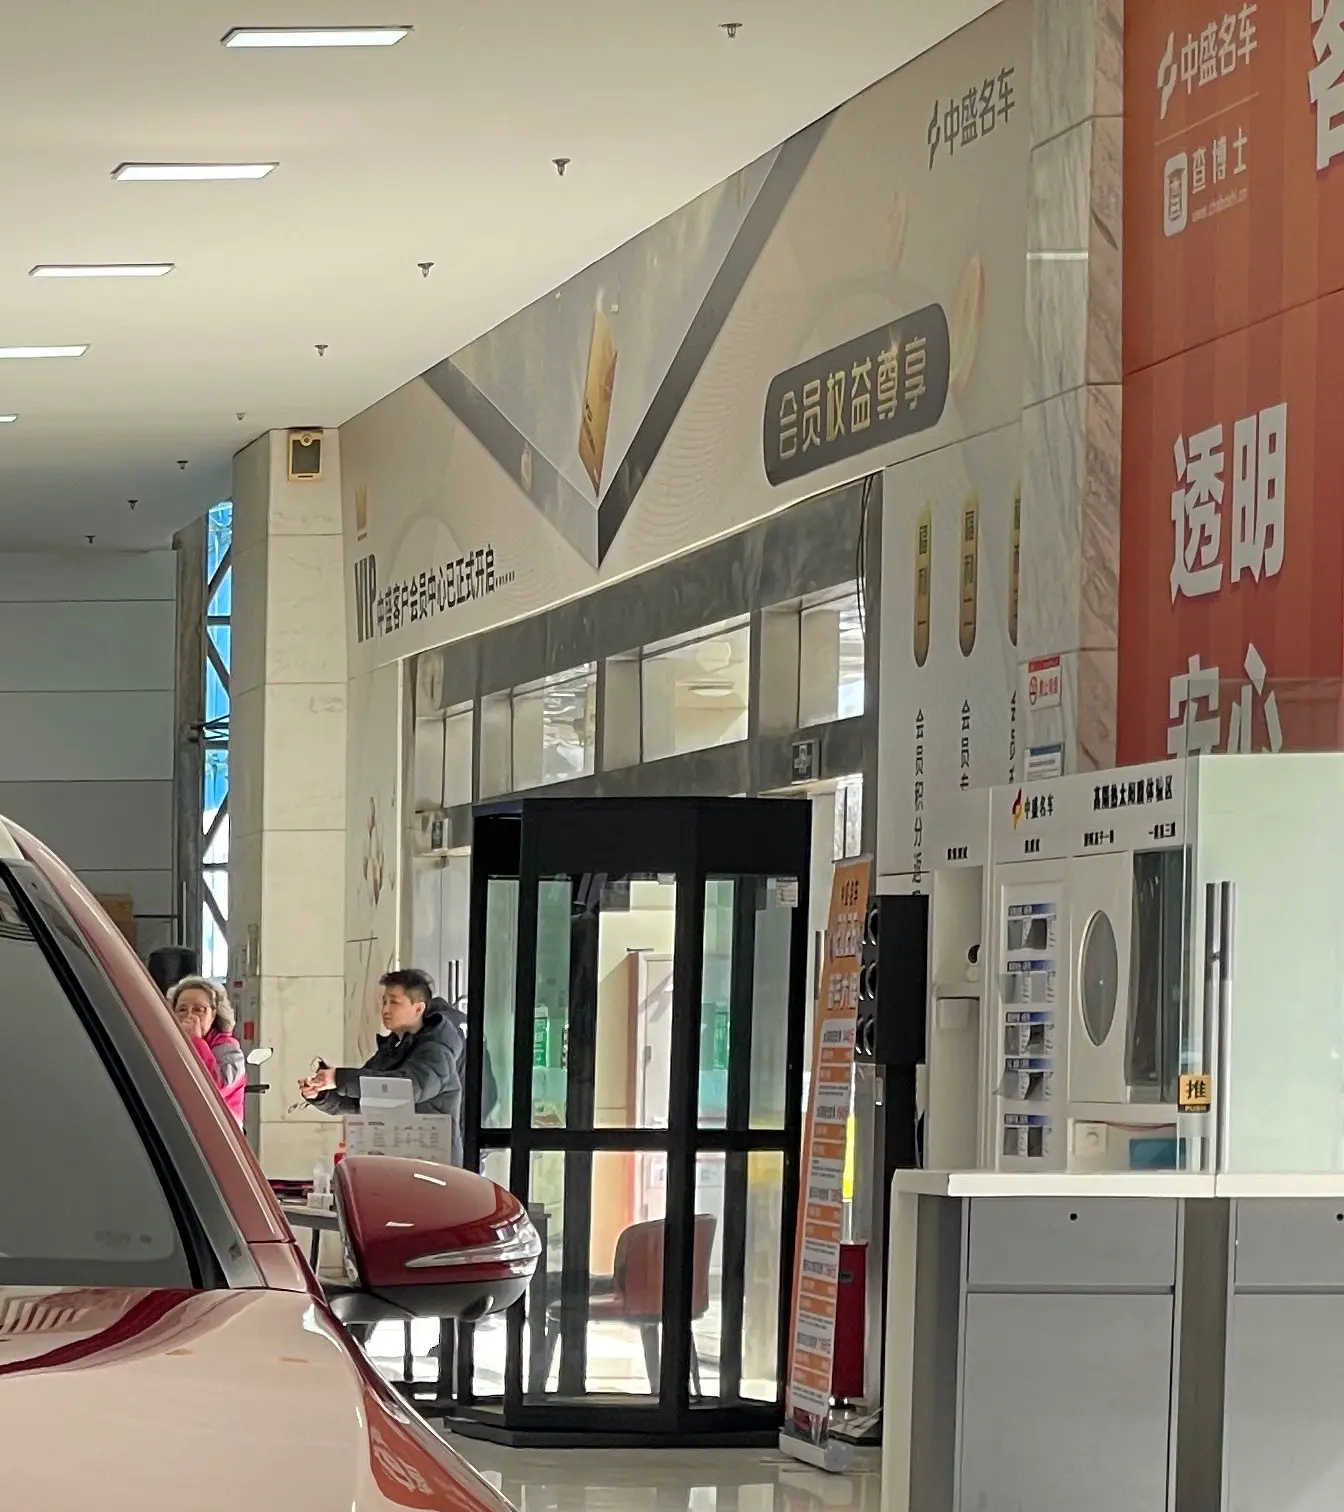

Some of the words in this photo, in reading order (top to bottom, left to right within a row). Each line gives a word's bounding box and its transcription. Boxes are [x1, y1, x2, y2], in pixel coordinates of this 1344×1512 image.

[1181, 4, 1257, 95] 中盛名车
[943, 67, 1015, 154] 中盛名车
[1192, 126, 1247, 194] 查博士
[777, 336, 929, 462] 会员权益尊享
[1171, 402, 1287, 603] 透明
[354, 554, 376, 644] VIP
[1184, 1079, 1207, 1100] 推
